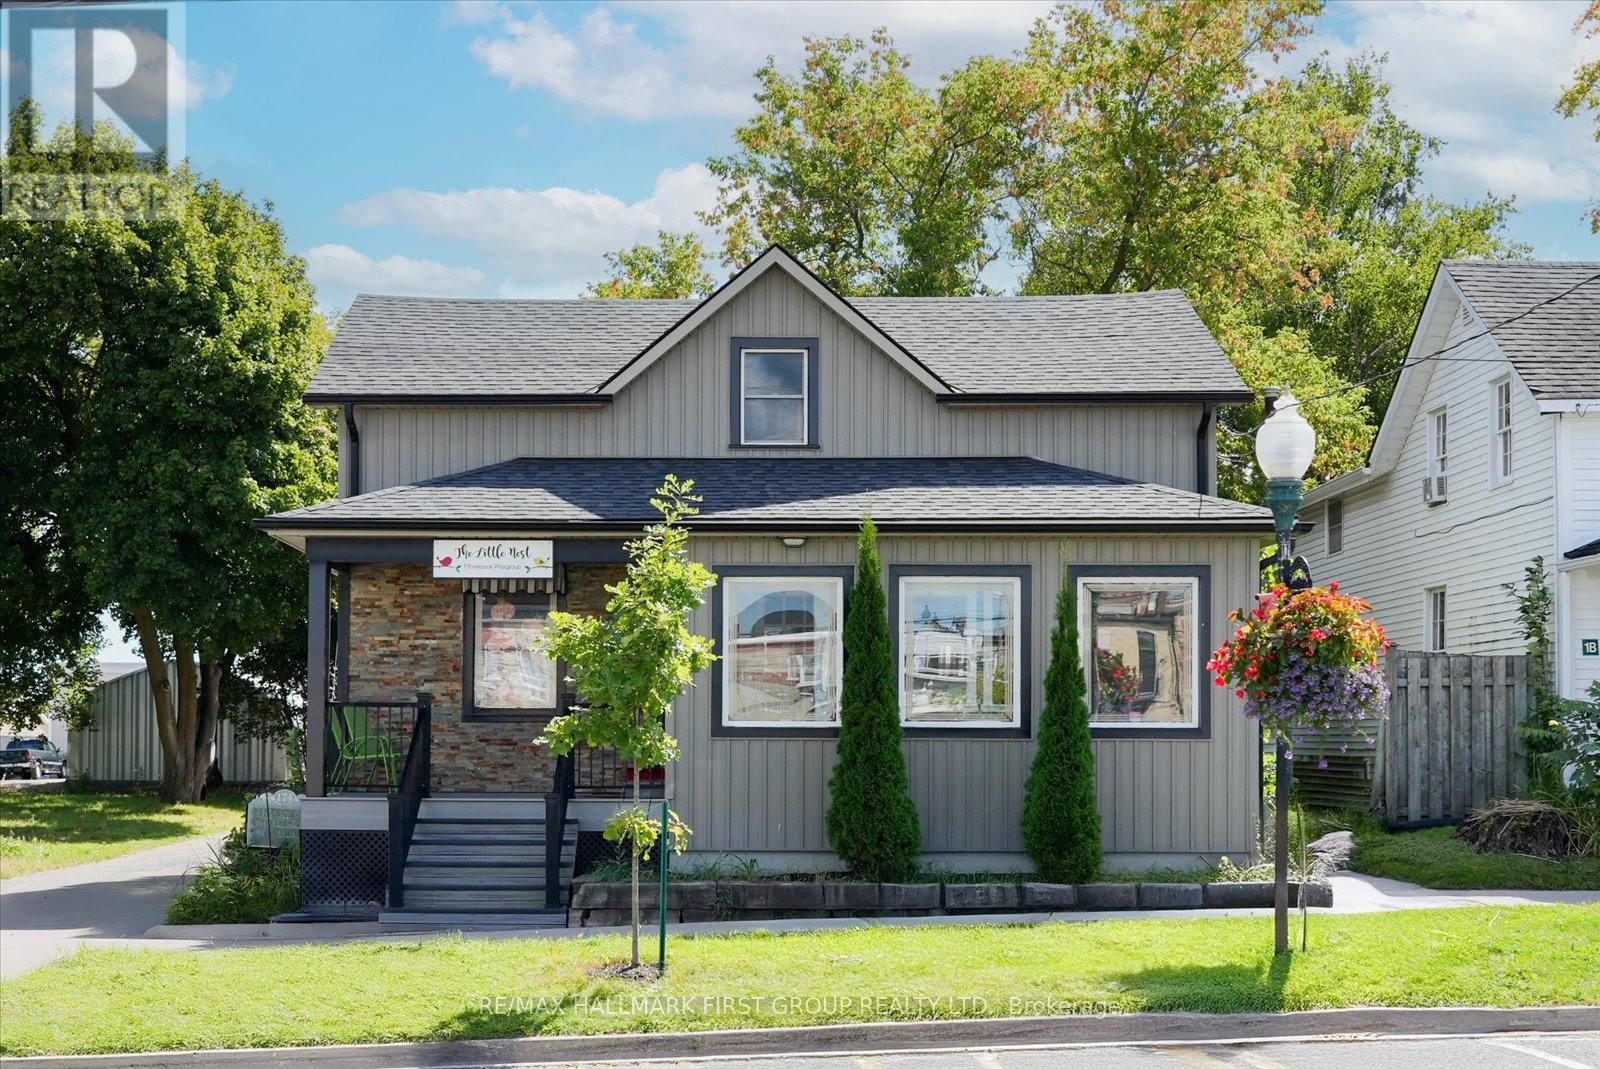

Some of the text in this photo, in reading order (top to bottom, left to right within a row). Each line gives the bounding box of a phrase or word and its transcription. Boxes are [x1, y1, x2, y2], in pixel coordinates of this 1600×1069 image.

[457, 544, 532, 559] The Little Nest
